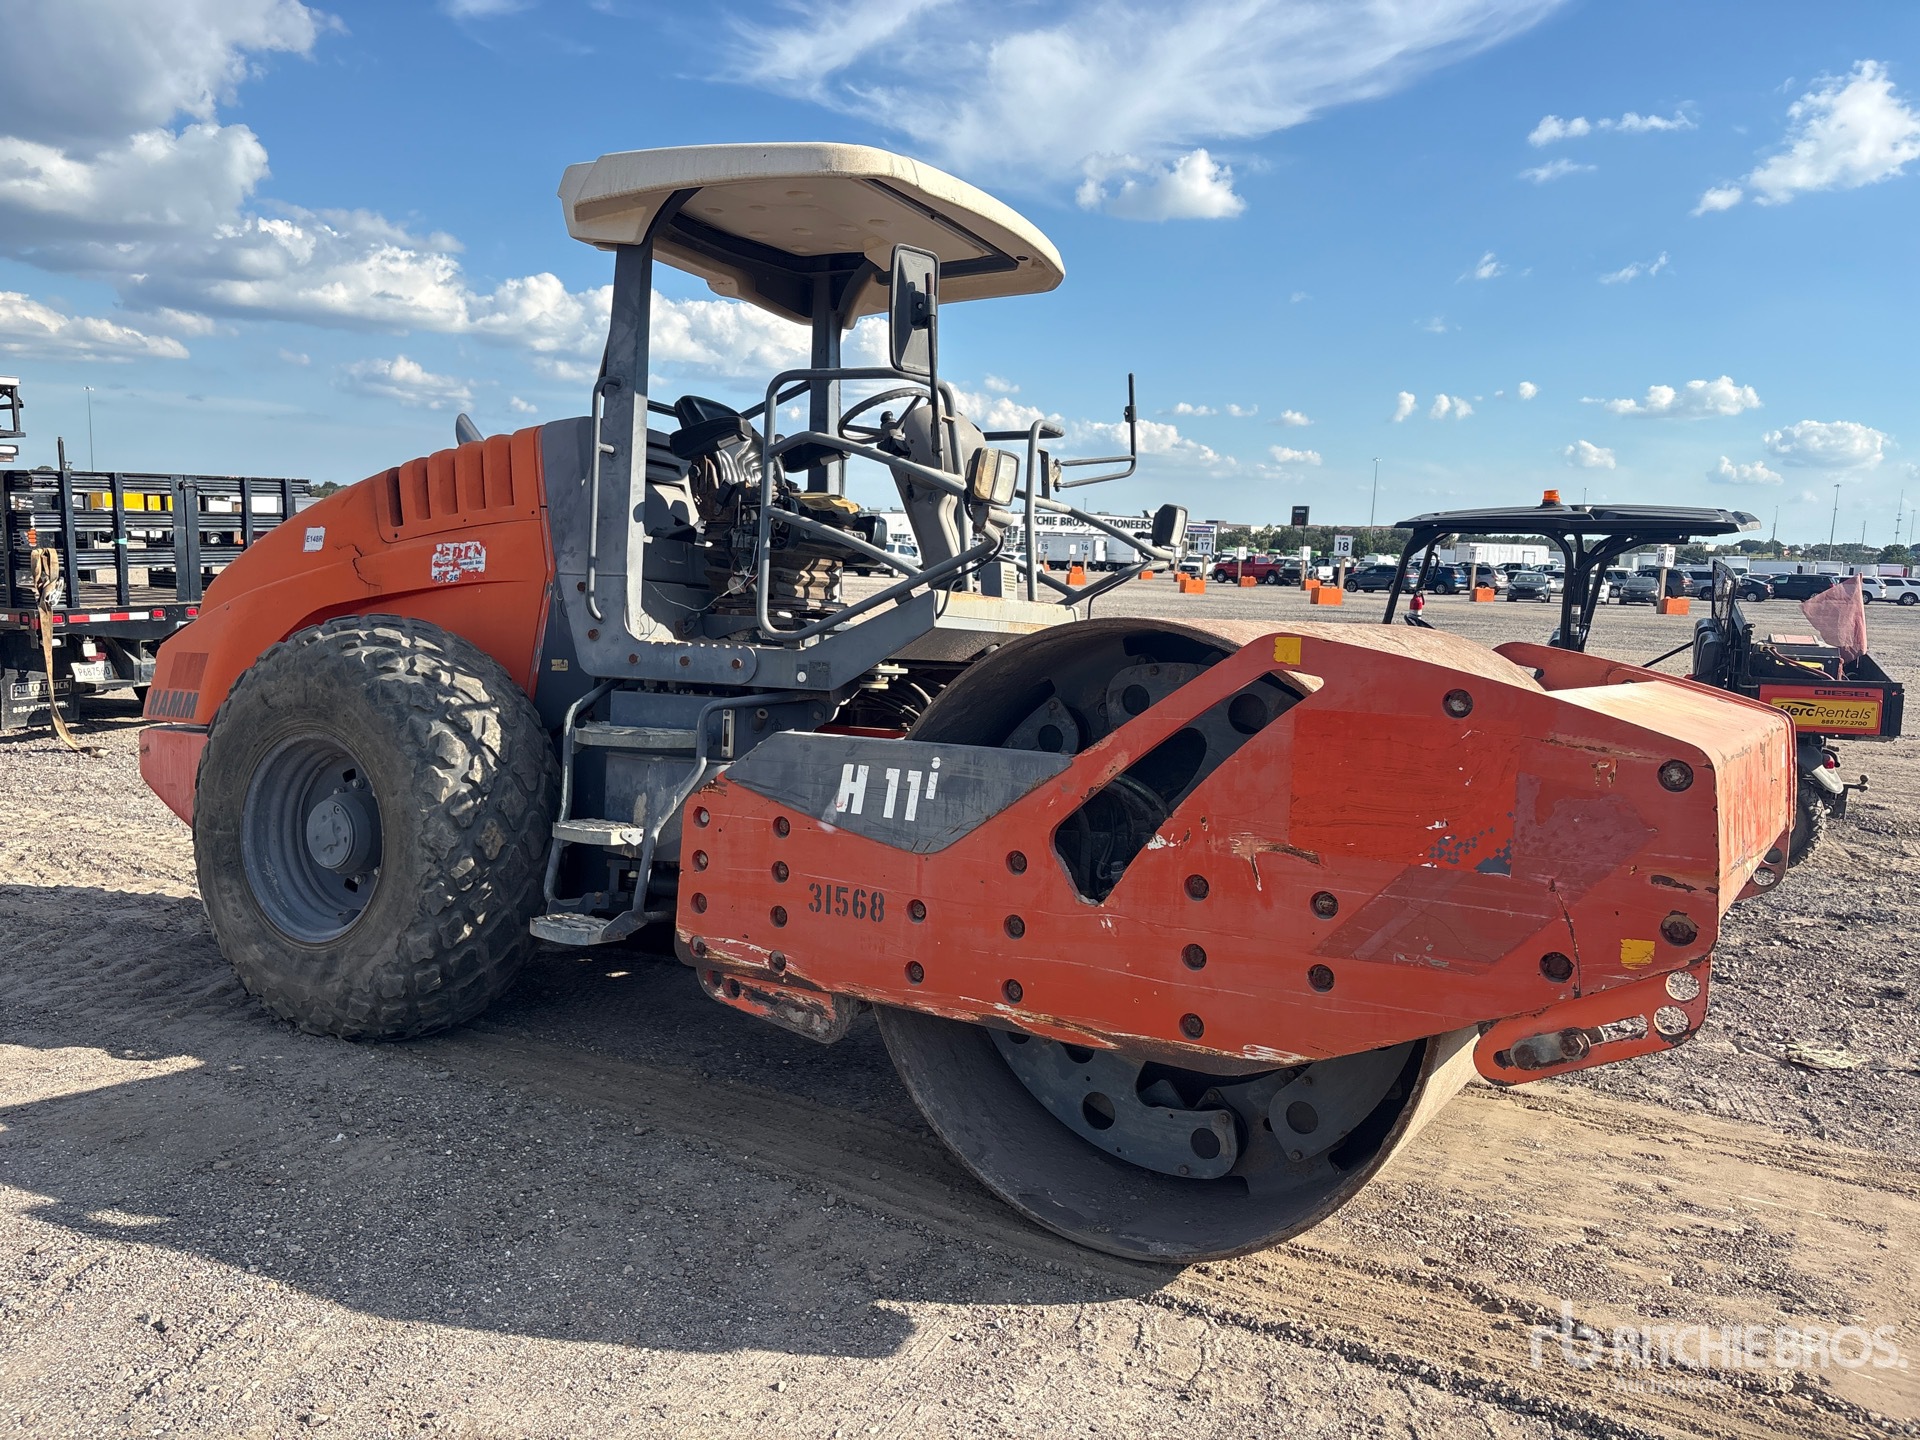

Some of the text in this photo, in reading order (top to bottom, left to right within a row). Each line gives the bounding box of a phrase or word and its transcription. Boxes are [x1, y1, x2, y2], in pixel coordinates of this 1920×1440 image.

[1201, 542, 1210, 550] 17
[1338, 542, 1350, 552] 18
[1469, 551, 1475, 560] 17
[1657, 553, 1665, 562] 18
[1666, 553, 1674, 563] 18
[14, 681, 70, 693] AUTO TUCK
[1814, 689, 1877, 698] DIESEL
[147, 689, 200, 720] HAMM
[1821, 719, 1868, 727] 888-777-2700
[836, 763, 870, 815] H
[808, 882, 885, 923] 31568
